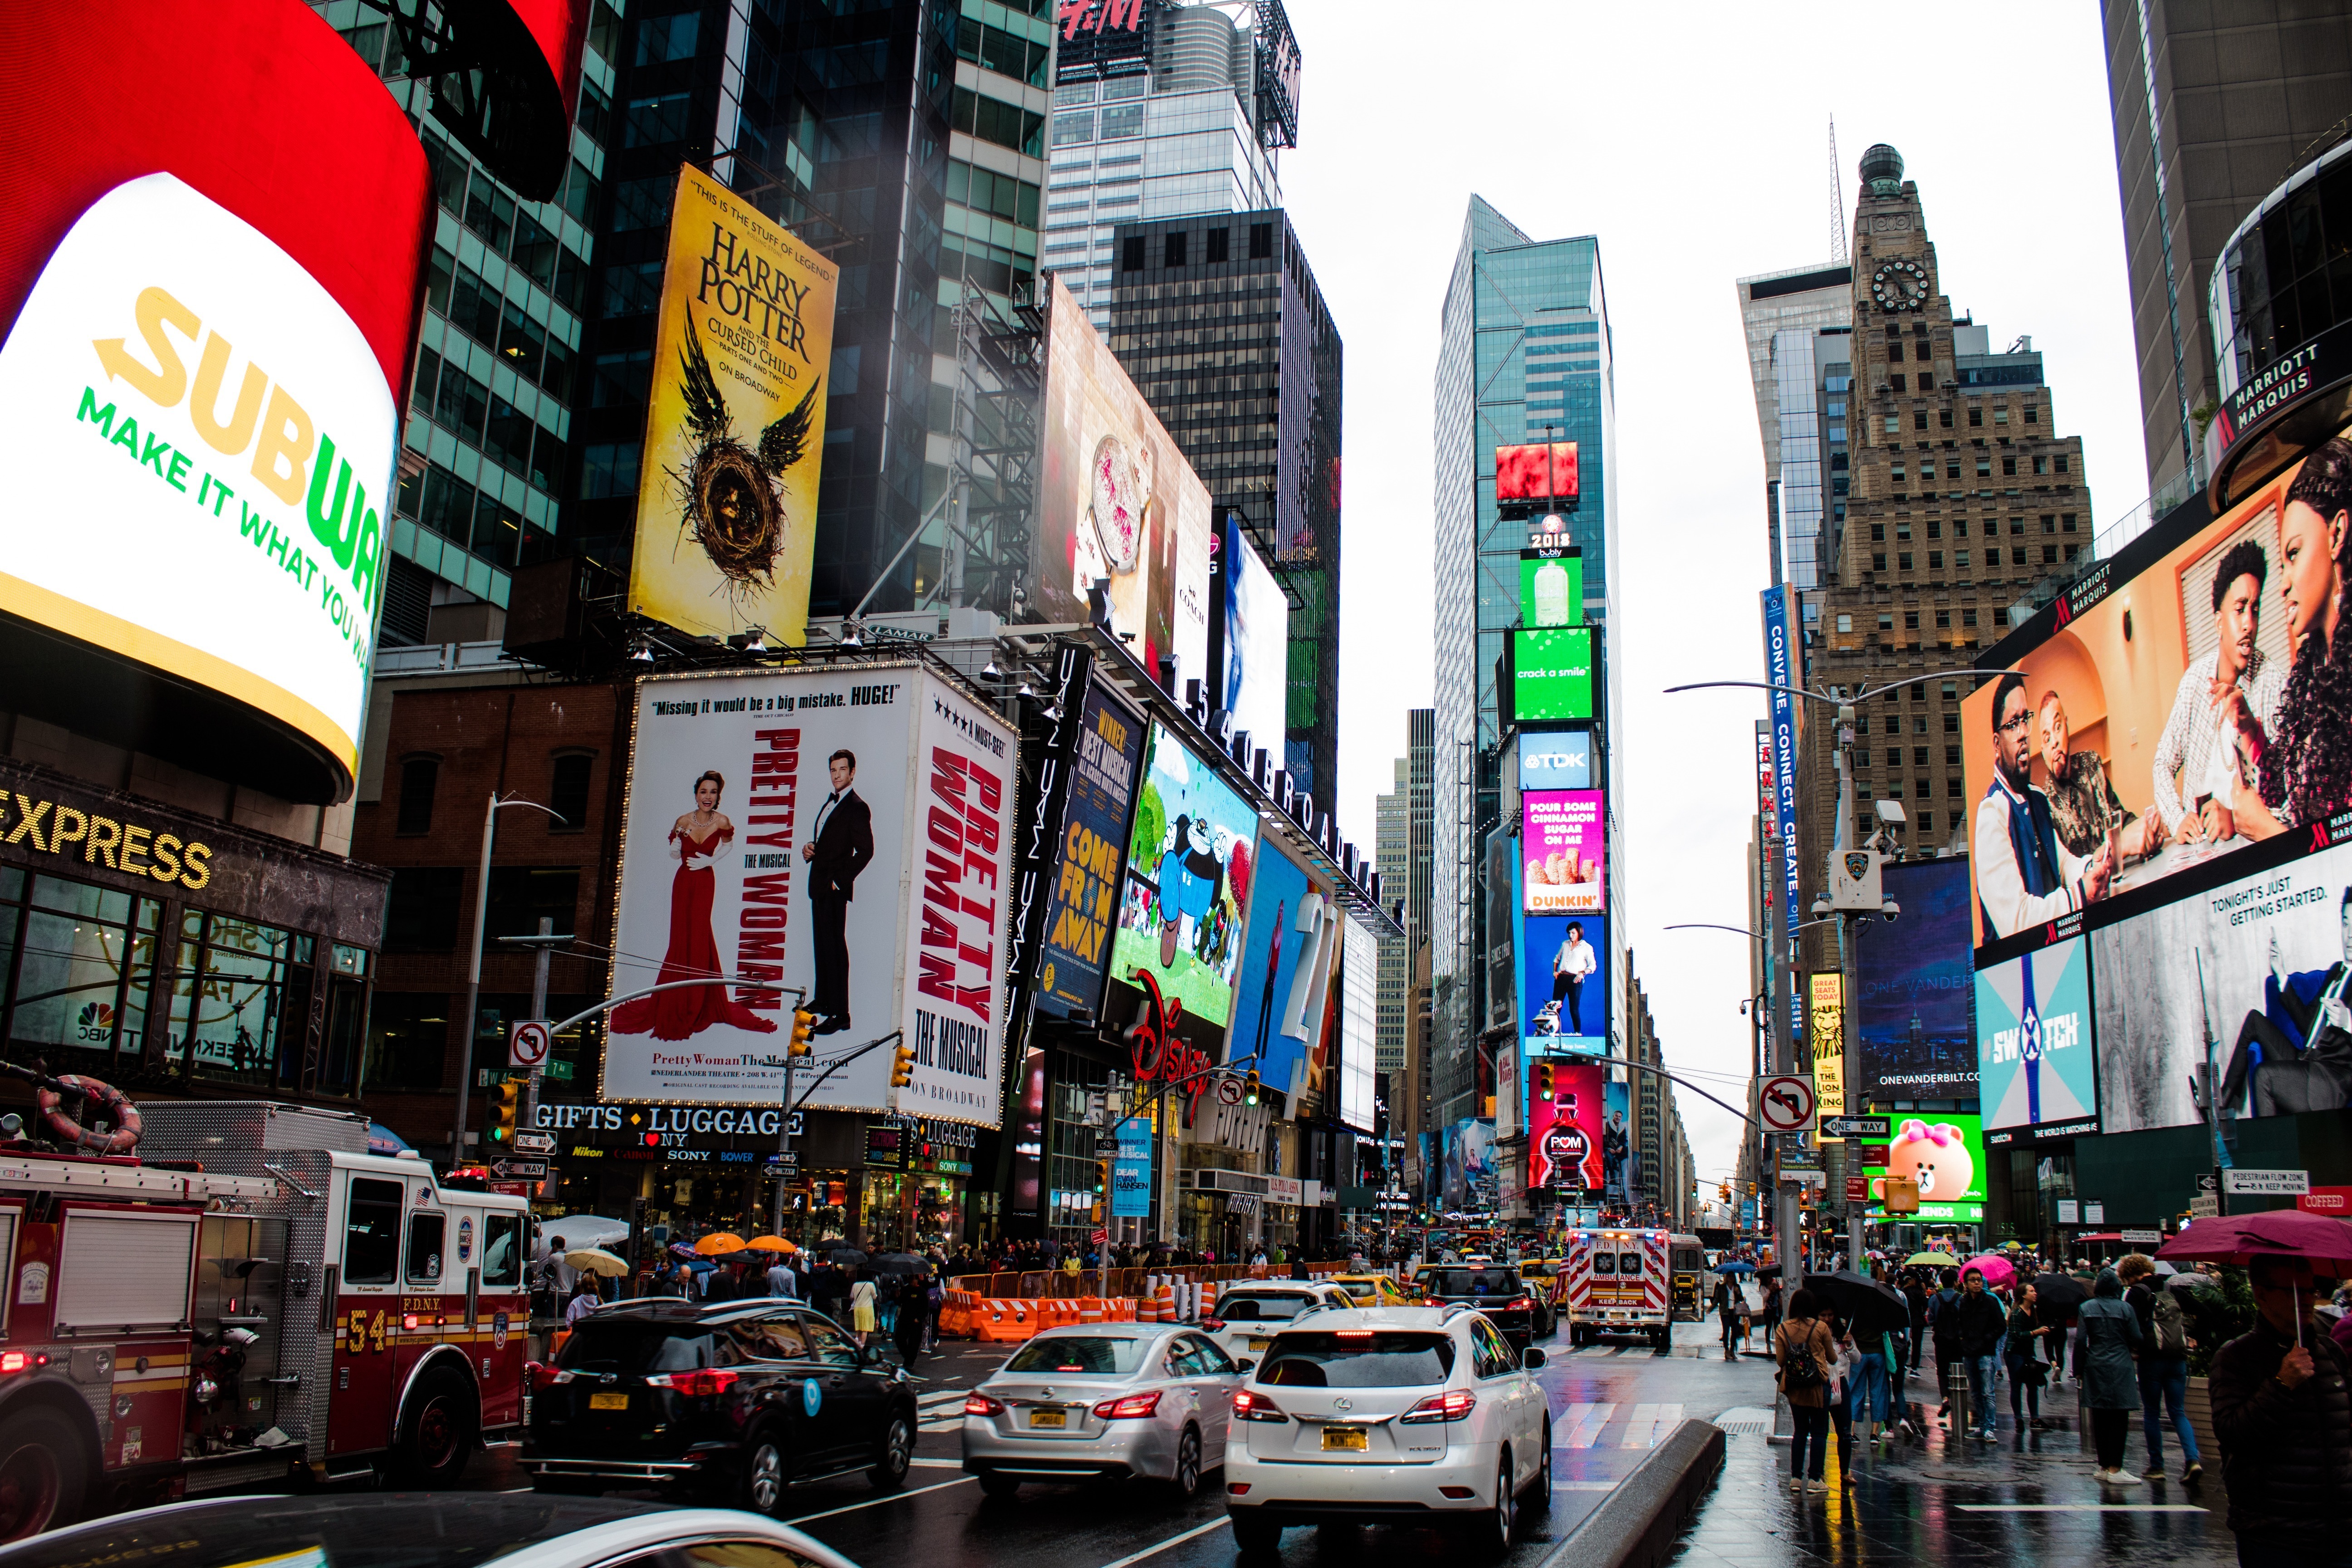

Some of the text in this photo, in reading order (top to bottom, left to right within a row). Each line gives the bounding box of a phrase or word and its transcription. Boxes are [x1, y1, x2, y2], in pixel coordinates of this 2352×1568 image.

[1274, 29, 1300, 112] H&M
[720, 200, 728, 213] IS
[731, 207, 749, 228] THE
[751, 221, 779, 247] STUFF
[781, 240, 794, 256] OF
[747, 231, 783, 259] ROLLING STONE
[709, 221, 811, 321] HARRY
[697, 256, 811, 364] POTTER
[708, 318, 797, 380] CURSED CHILD
[737, 325, 770, 349] AND THE
[719, 342, 784, 385] PARTS ONE AND TWO
[2236, 343, 2318, 409] MARRIOTT
[718, 361, 781, 403] ON BROADWAY
[2238, 371, 2309, 430] MARQUIS
[92, 286, 383, 616] SUBWA
[76, 386, 354, 640] MAKE IT WHAT YOU
[1532, 533, 1571, 548] 2018
[2071, 563, 2111, 600] MARRIOTT
[1180, 589, 1204, 626] COACH
[2072, 581, 2108, 615] MARQUIS
[1517, 669, 1546, 678] crack
[1771, 625, 1788, 715] CONVENE.
[701, 699, 710, 714] it
[714, 697, 745, 713] would
[750, 697, 763, 711] be
[778, 695, 794, 712] big
[799, 693, 846, 709] mistake.
[1097, 707, 1127, 755] WINNER!
[1081, 727, 1103, 767] BEST
[1100, 742, 1132, 792] MUSICAL
[1539, 753, 1586, 768] TDK
[1778, 723, 1794, 813] CONNECT.
[746, 728, 801, 849] PRETTY
[1078, 758, 1087, 776] ALL
[1086, 763, 1102, 787] ACROSS
[1101, 774, 1113, 797] NORTH
[1111, 783, 1128, 807] AMERICA
[1530, 802, 1597, 813] POUR SOME
[1530, 813, 1595, 824] CINNAMON
[1544, 824, 1583, 835] SUGAR
[1544, 835, 1583, 846] ON ME
[744, 853, 791, 869] THE MUSICAL
[1066, 820, 1120, 886] COME
[1784, 821, 1798, 897] CREATE.
[917, 745, 968, 1004] WOMAN
[956, 759, 1002, 1025] PRETTY
[1532, 895, 1597, 908] DUNKIN'
[2211, 876, 2291, 913] TONIGHT'S JUST
[2230, 886, 2328, 926] GETTING STARTED.
[2057, 912, 2083, 928] MARRIOTT
[2058, 923, 2081, 938] MARQUIS
[734, 872, 790, 1010] WOMAN
[1050, 907, 1107, 966] AWAY
[1280, 892, 1338, 1049] 21
[1865, 980, 1900, 995] ONE
[915, 1008, 936, 1067] THE
[938, 1016, 988, 1080] MUSICAL
[1817, 1082, 1839, 1092] LION
[1880, 1072, 1981, 1085] ONEVANDERBILT.CO
[912, 1081, 987, 1108] ON BROADWAY
[1817, 1095, 1842, 1108] KING
[535, 1104, 804, 1136] GIFTS LUGGAGE
[926, 1119, 977, 1149] LUGGAGE
[1831, 1122, 1882, 1132] ONE WAY
[2065, 1123, 2090, 1134] WATCHING
[518, 1136, 551, 1147] ONE WAY
[572, 1146, 603, 1157] Nikon
[614, 1148, 654, 1161] Canon
[667, 1151, 710, 1161] SONY
[498, 1163, 544, 1174] ONE WAY
[721, 1152, 754, 1162] BOWER
[939, 1161, 958, 1172] SONY
[1279, 1179, 1288, 1192] POLO
[2305, 1194, 2344, 1207] COFFEED
[1596, 1241, 1639, 1250] F.D. N.Y.
[403, 1298, 441, 1311] F.D.N.Y.
[349, 1309, 385, 1352] 54
